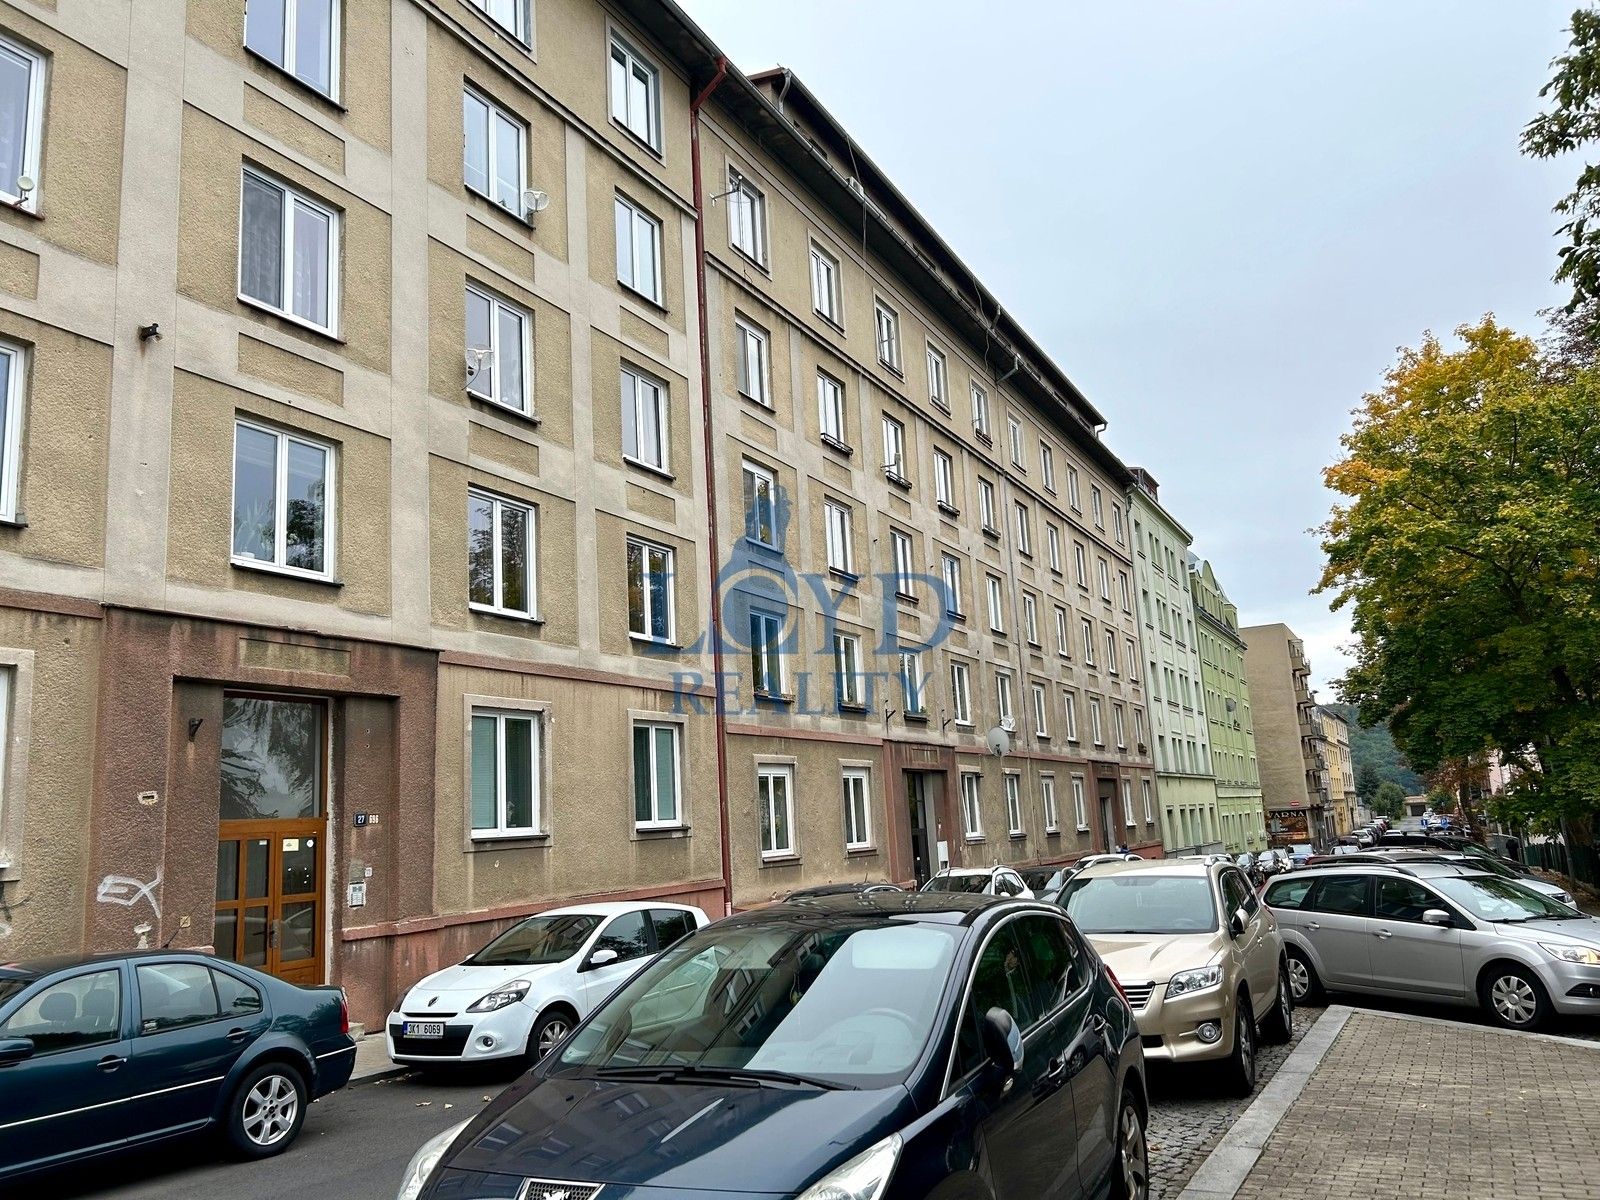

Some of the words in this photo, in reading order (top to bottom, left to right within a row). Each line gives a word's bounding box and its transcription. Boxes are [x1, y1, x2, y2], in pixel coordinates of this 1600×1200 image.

[357, 815, 365, 824] 27
[408, 1023, 420, 1034] 3K1
[424, 1024, 441, 1034] 6069
